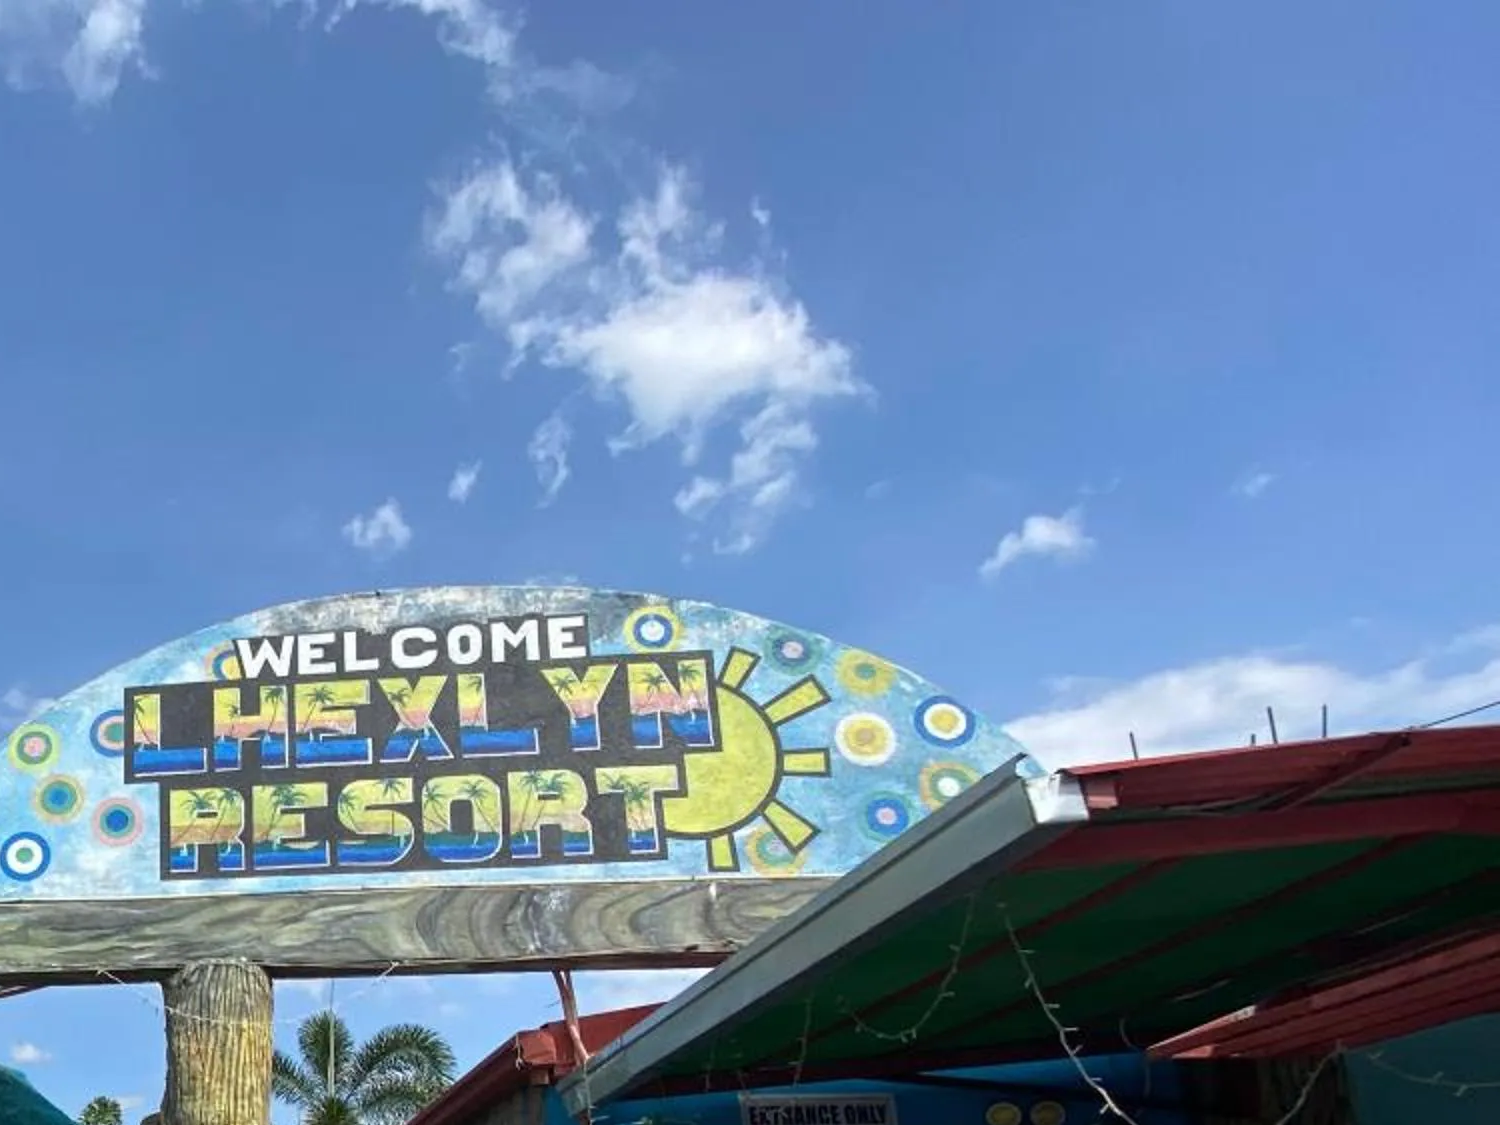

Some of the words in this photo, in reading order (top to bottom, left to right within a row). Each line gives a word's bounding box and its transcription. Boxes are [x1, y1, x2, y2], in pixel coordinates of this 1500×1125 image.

[234, 615, 587, 678] WELCOME
[131, 658, 716, 775] LHEXLYN
[169, 765, 679, 873] RESORT
[845, 1103, 887, 1125] ONLY
